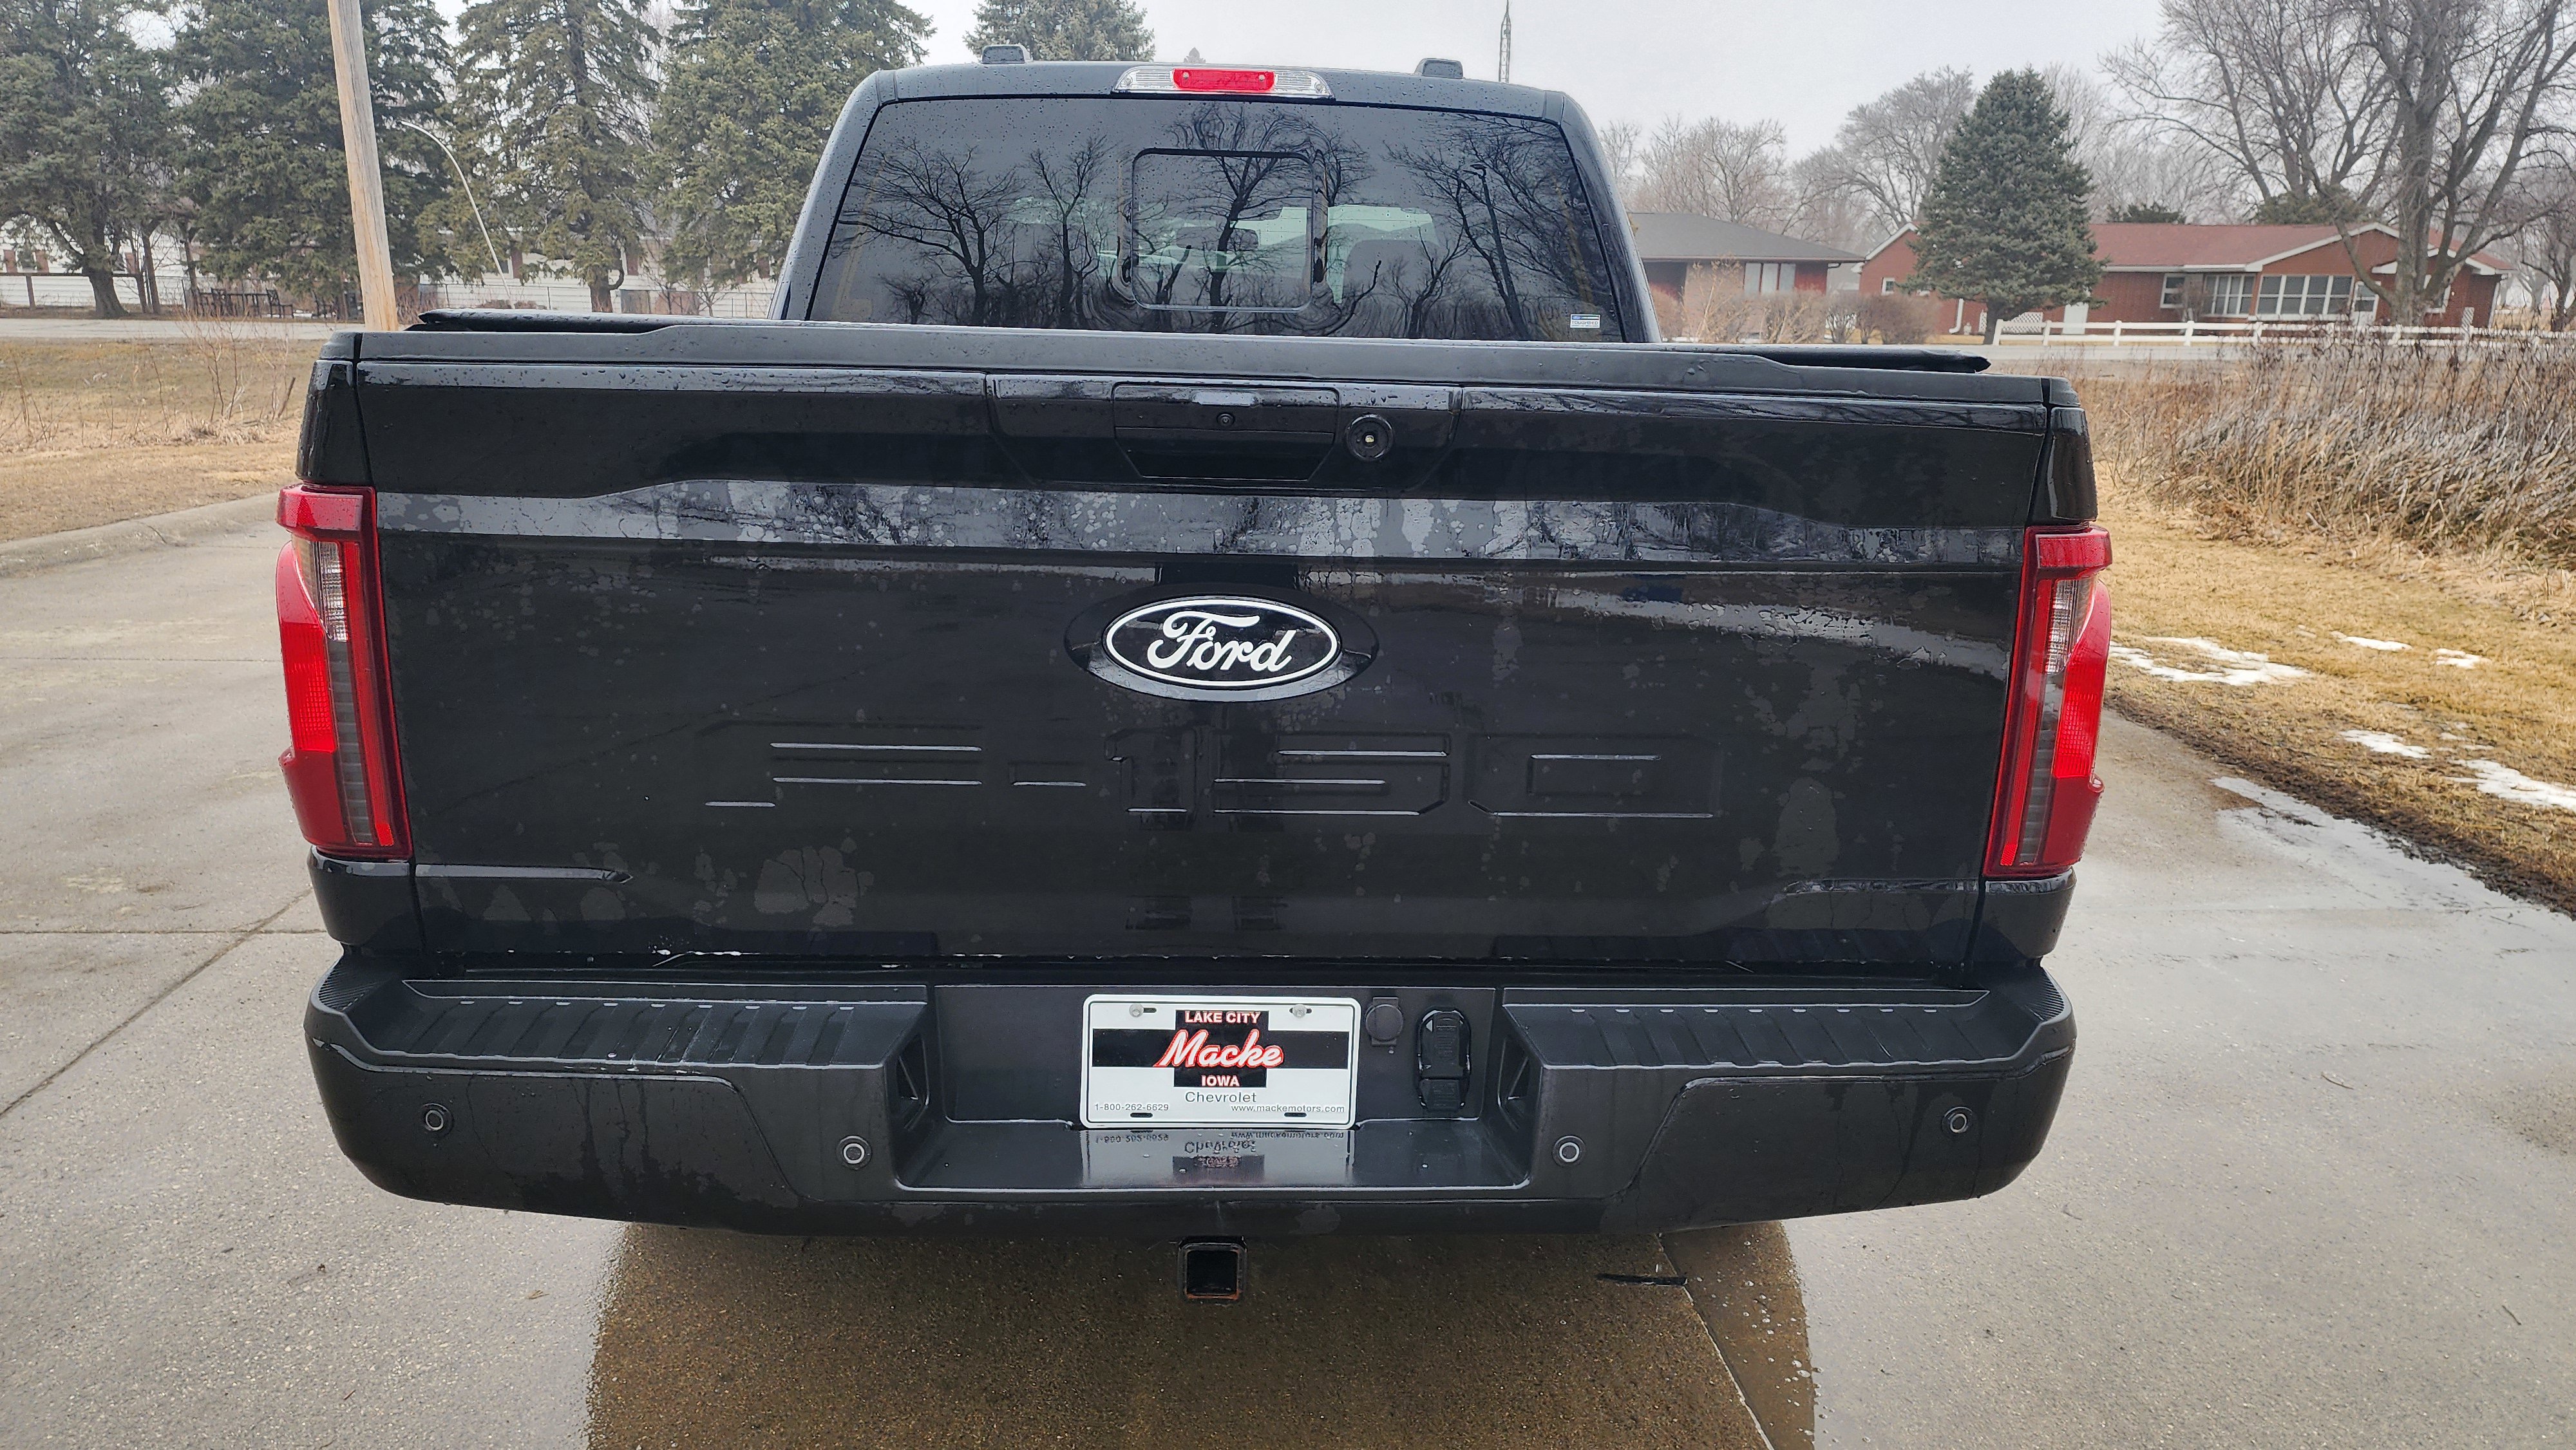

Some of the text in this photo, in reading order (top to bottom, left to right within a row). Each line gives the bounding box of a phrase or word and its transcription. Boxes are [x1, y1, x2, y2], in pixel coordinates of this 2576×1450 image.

[1147, 610, 1296, 672] Ford
[1184, 1011, 1261, 1024] LAKE CITY
[1153, 1028, 1284, 1068] Macke
[1201, 1075, 1240, 1087] IOWA
[1185, 1091, 1256, 1103] Chevrolet
[1231, 1104, 1345, 1113] www.mackemotors.com
